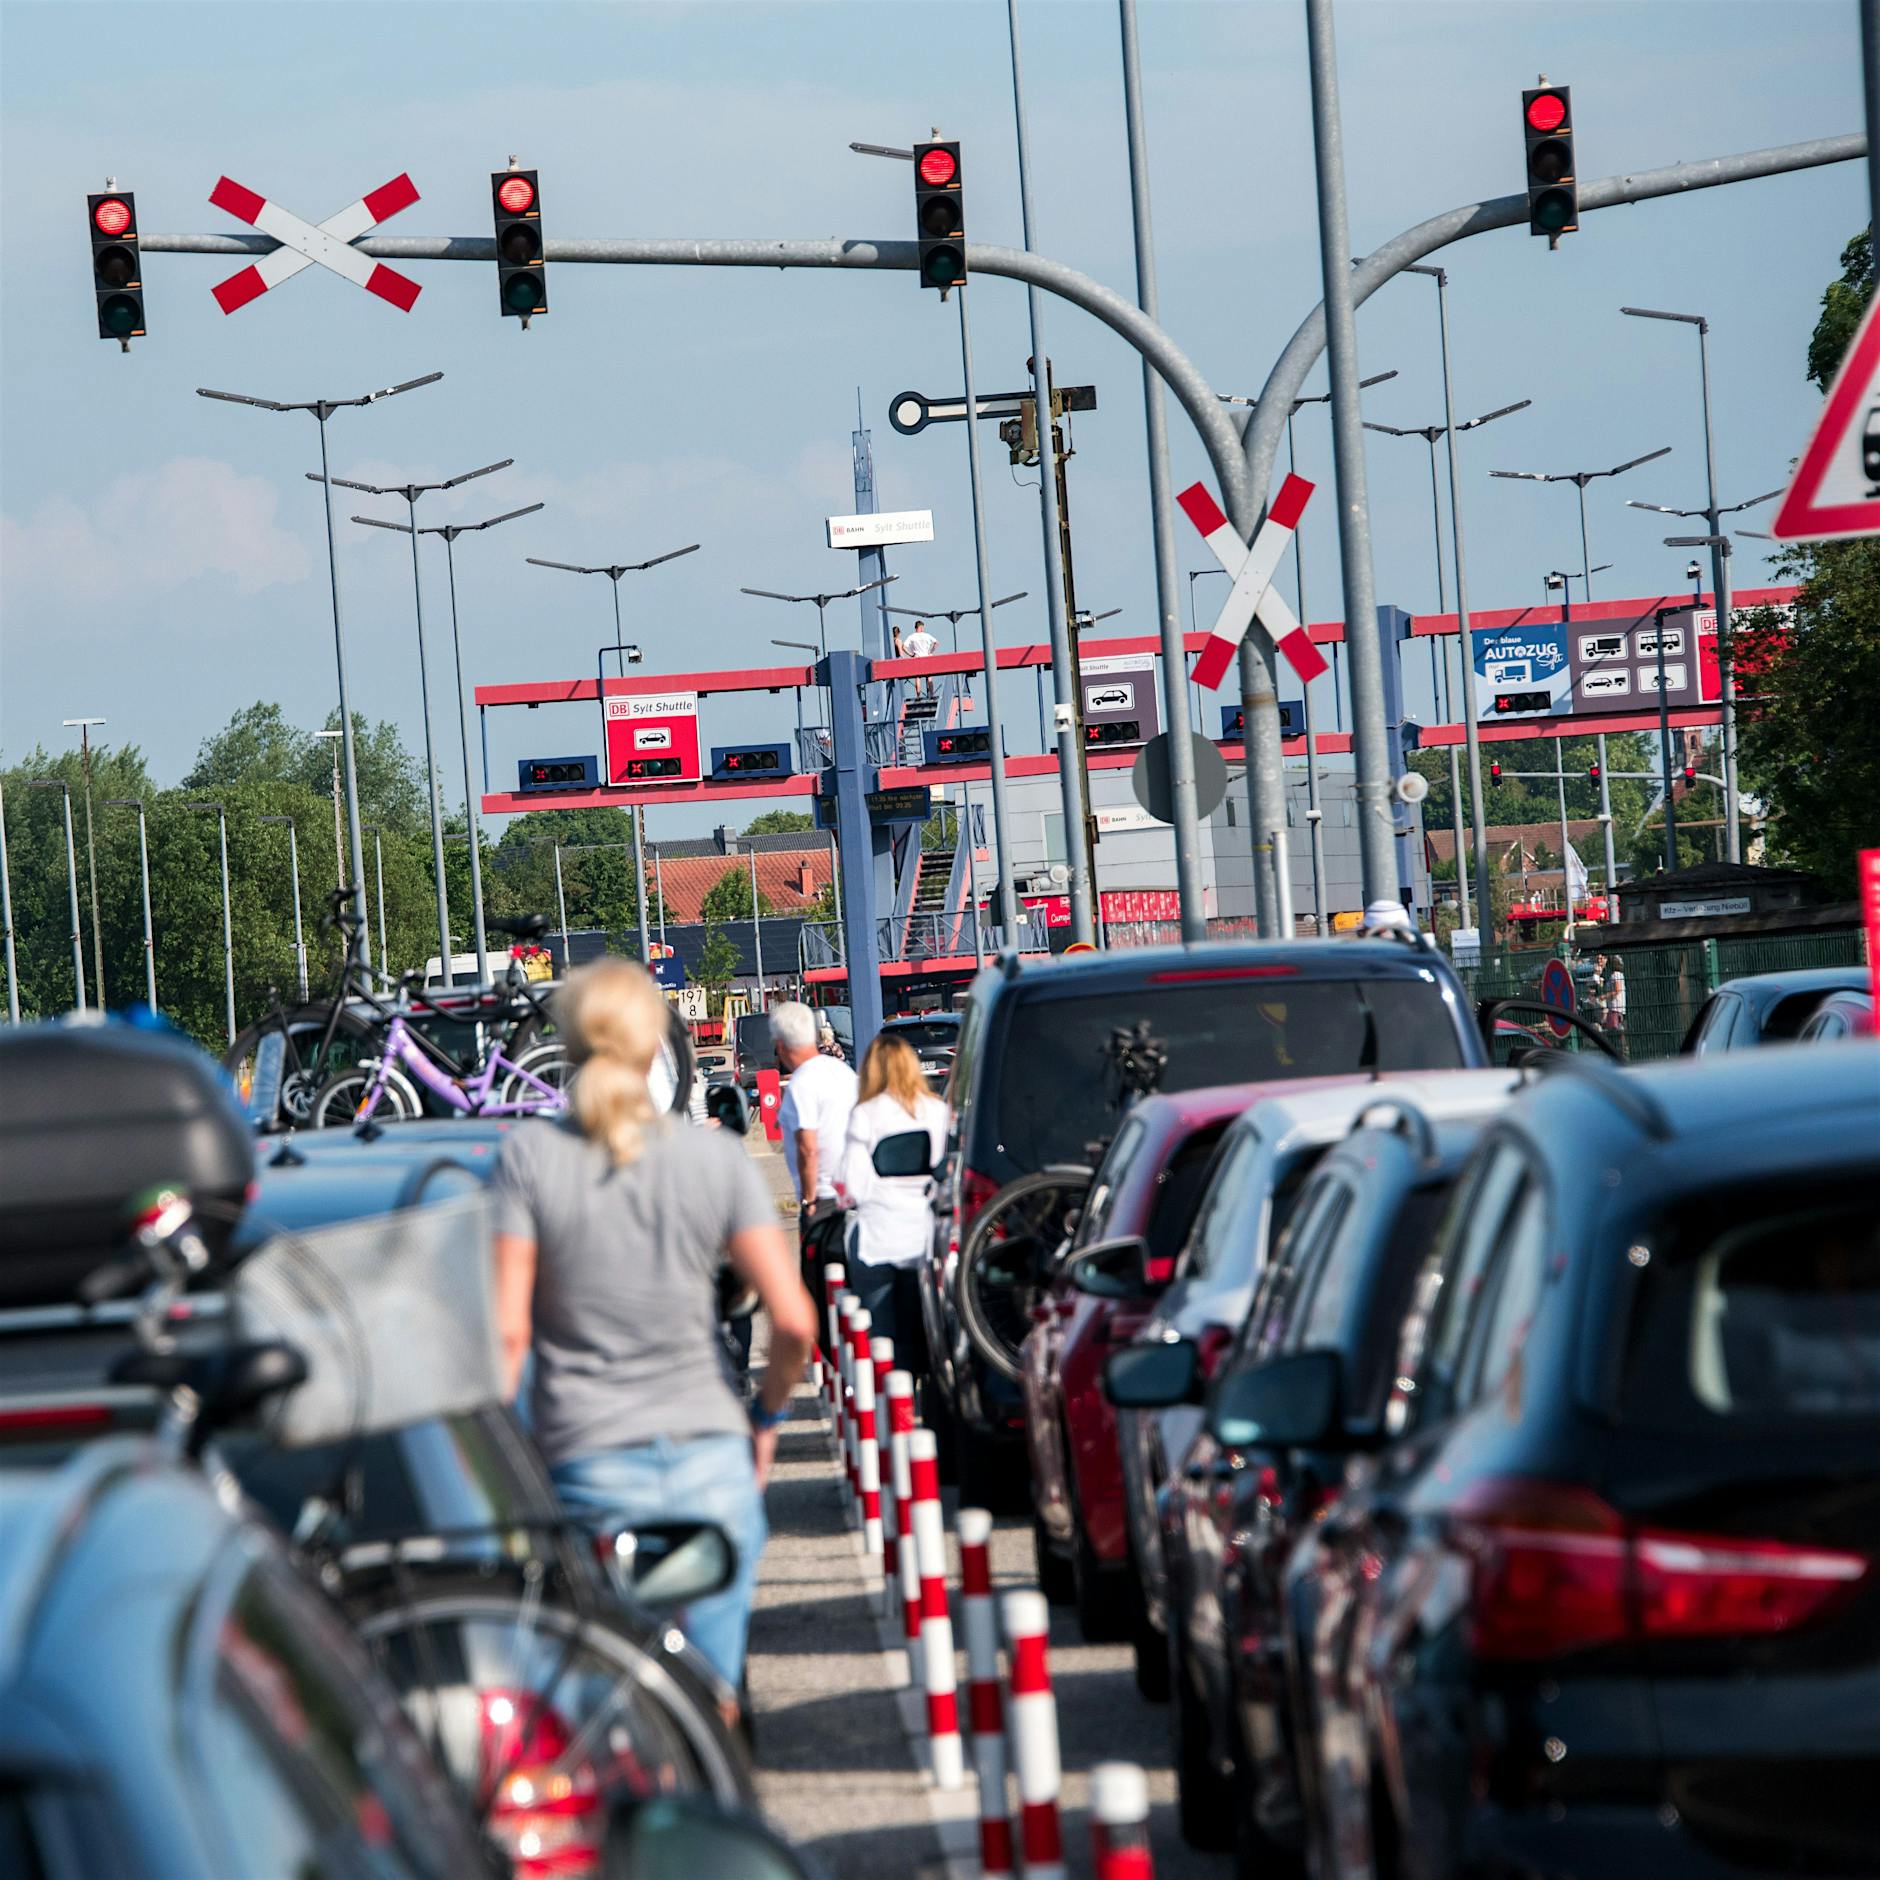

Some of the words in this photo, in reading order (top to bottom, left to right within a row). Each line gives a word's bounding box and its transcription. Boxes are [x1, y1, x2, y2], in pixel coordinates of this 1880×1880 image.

[874, 523, 893, 534] Sylt
[896, 520, 930, 531] Shuttle
[1500, 636, 1522, 644] blaue
[1485, 642, 1558, 660] AUTOZUG
[610, 703, 628, 715] DB
[633, 703, 653, 714] Sylt
[655, 701, 693, 712] Shuttle
[681, 989, 703, 1003] 197
[689, 1004, 697, 1016] 8
